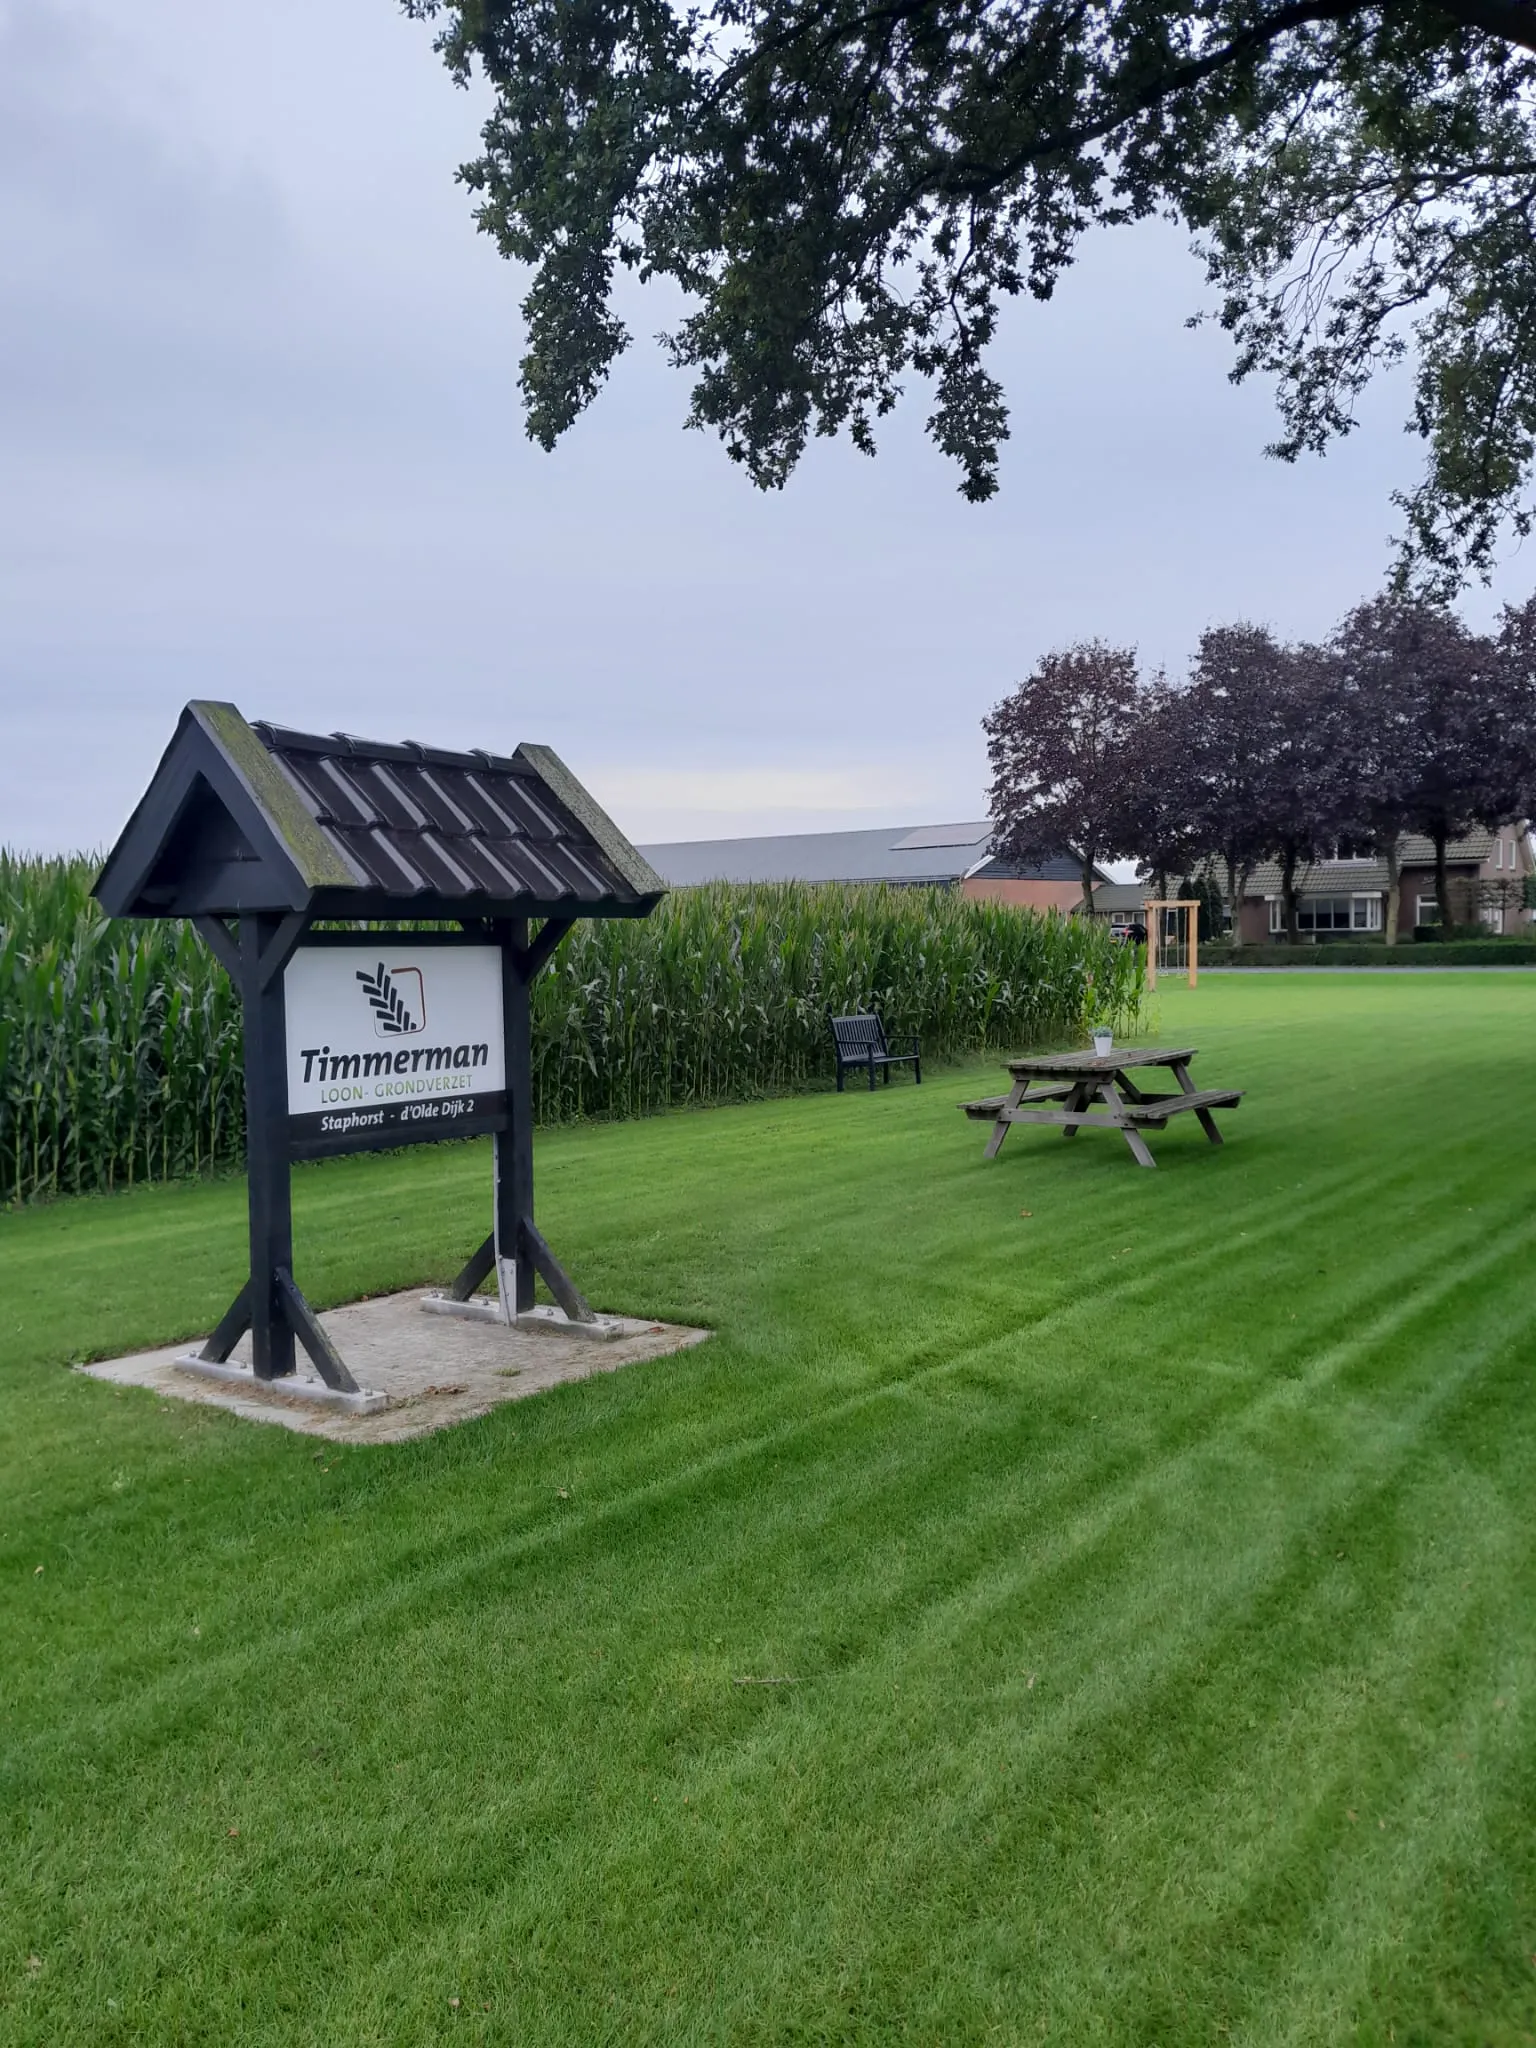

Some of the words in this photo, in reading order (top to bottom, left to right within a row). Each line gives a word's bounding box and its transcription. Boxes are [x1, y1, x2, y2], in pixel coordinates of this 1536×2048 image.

[301, 1043, 489, 1083] Timmerman
[321, 1086, 368, 1104] LOON-
[375, 1074, 473, 1098] GRONDVERZET
[320, 1110, 384, 1132] Staphorst
[441, 1101, 465, 1118] Dijk
[466, 1099, 475, 1112] 2
